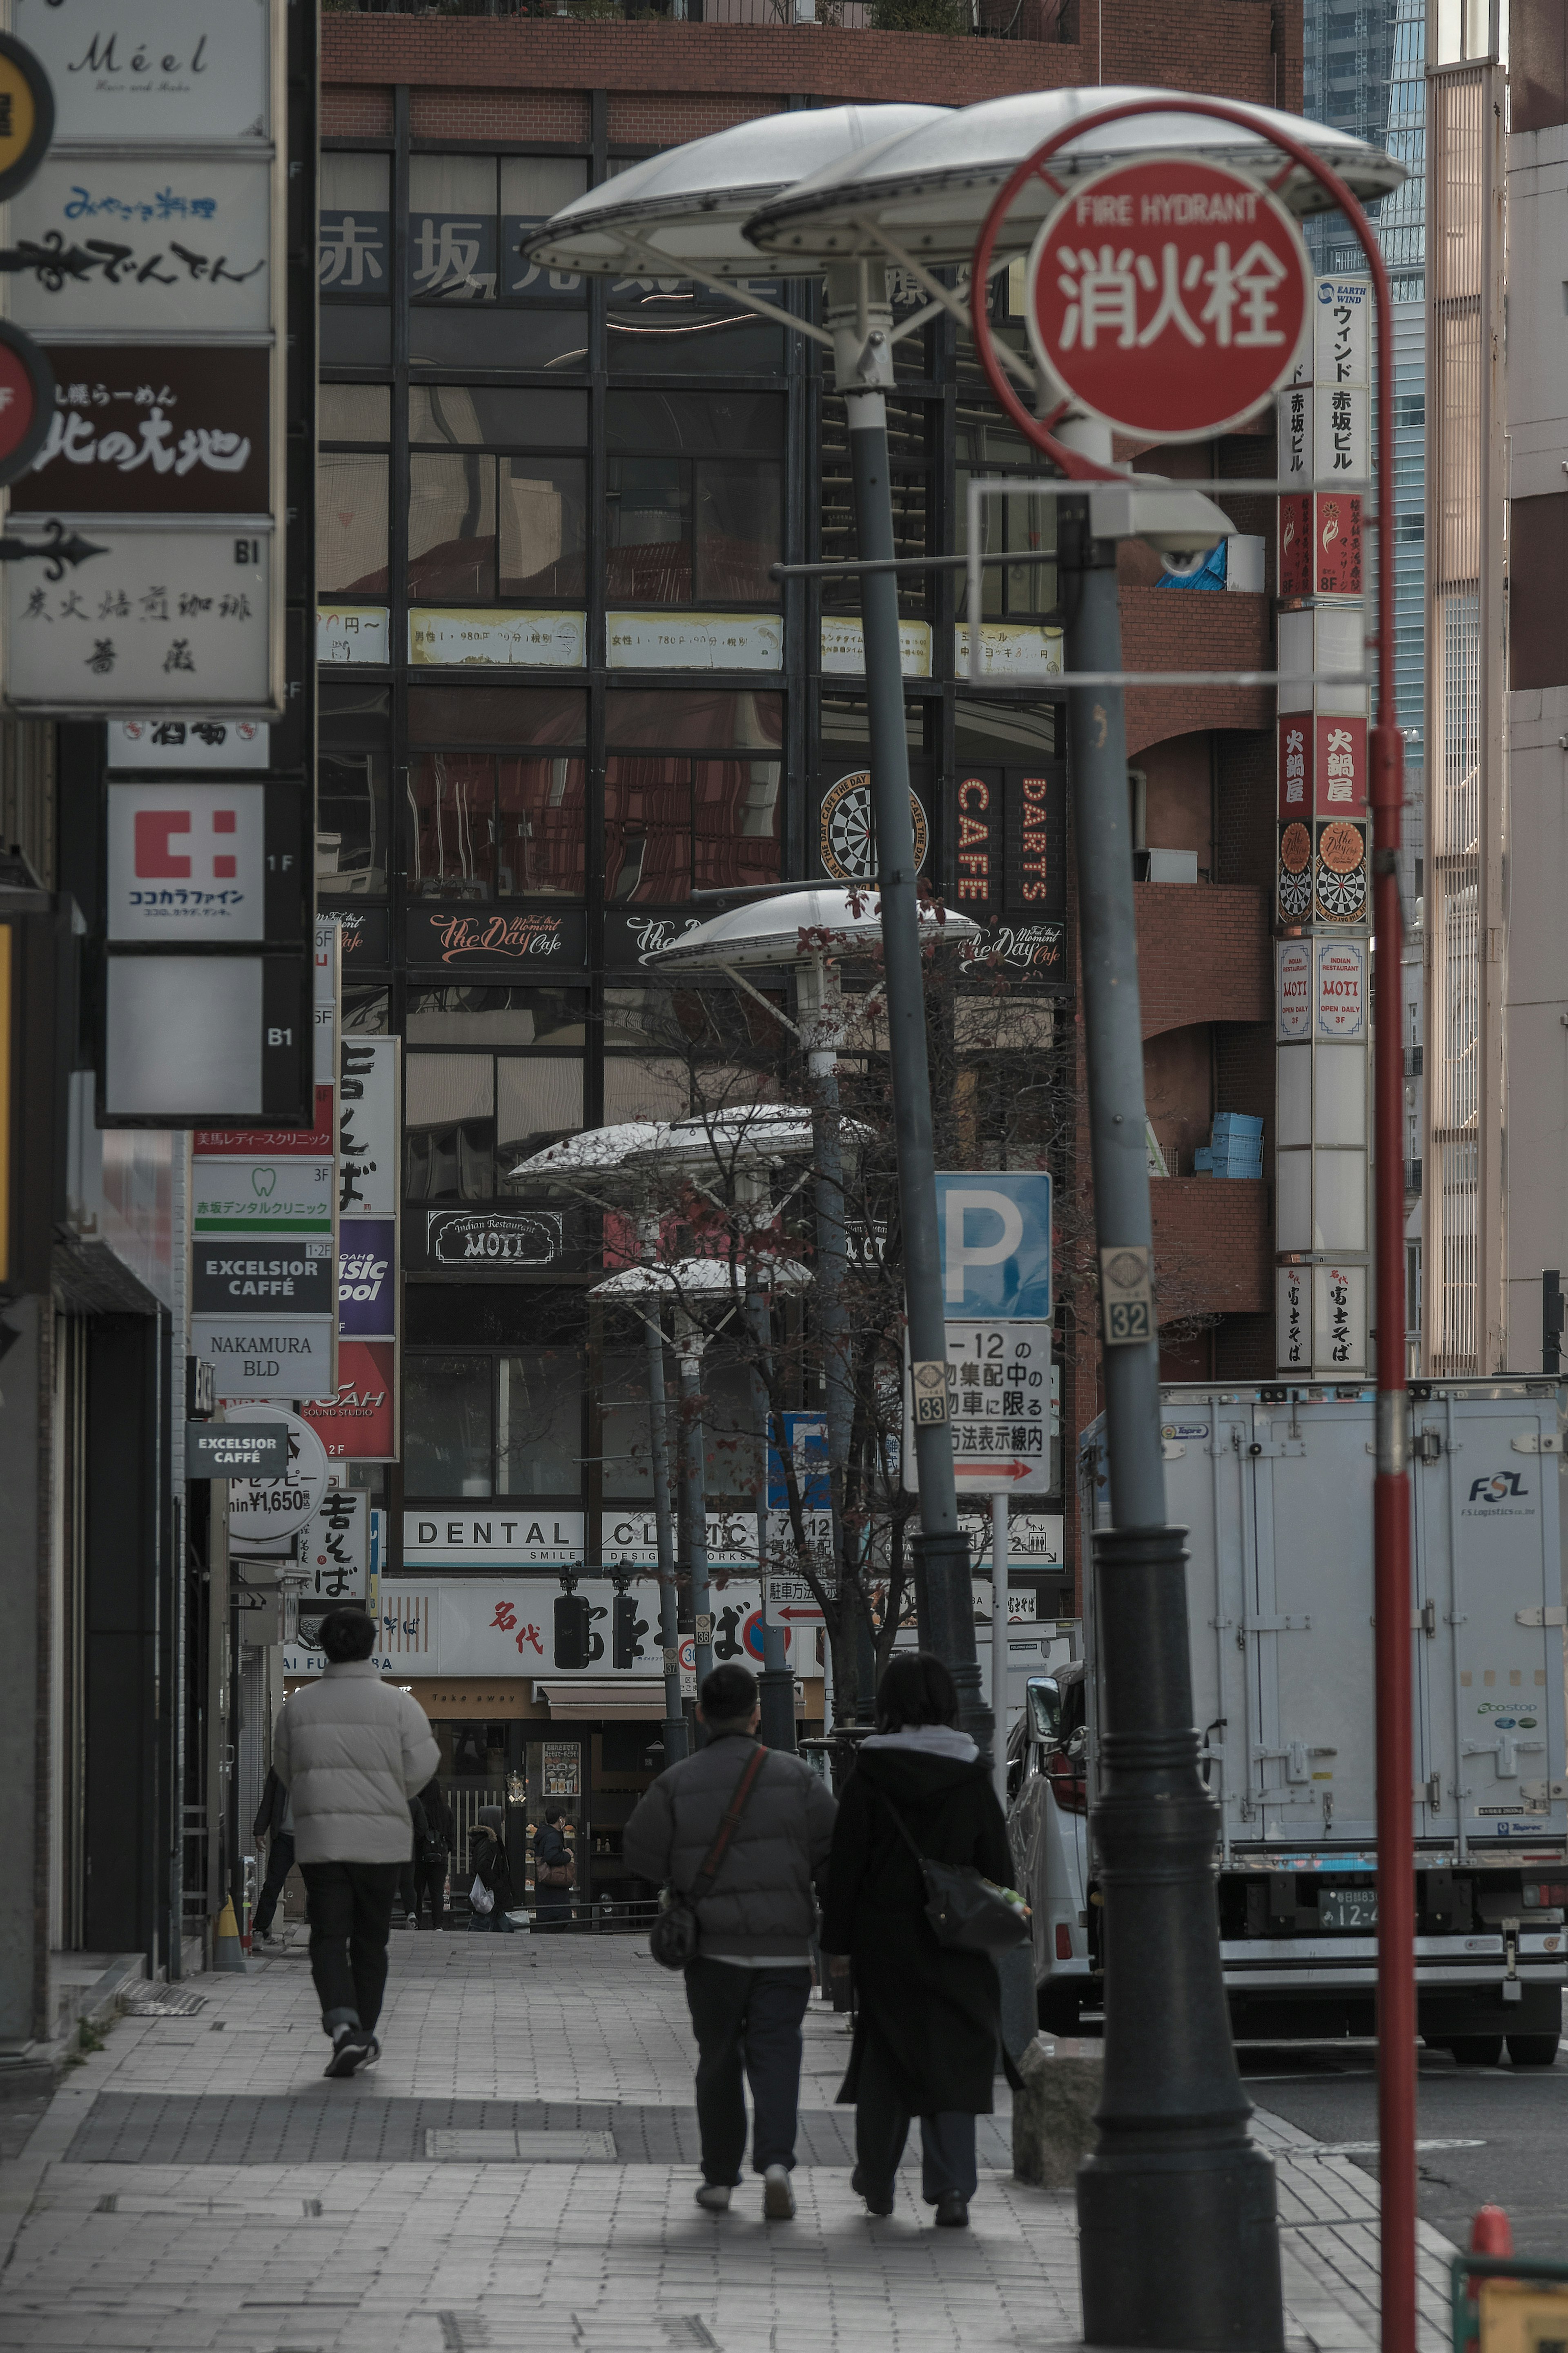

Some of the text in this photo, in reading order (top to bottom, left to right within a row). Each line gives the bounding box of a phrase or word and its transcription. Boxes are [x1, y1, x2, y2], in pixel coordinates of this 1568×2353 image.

[67, 31, 208, 73] Méel
[1075, 192, 1261, 226] FIRE HYDRANT
[1055, 240, 1288, 350] 消火栓
[1337, 286, 1367, 295] EARTH
[1337, 296, 1362, 304] WIND
[1332, 306, 1352, 470] ウィンド 赤坂ビル
[33, 407, 251, 475] 北の大地
[1290, 393, 1304, 472] 赤坂ビル
[1283, 579, 1293, 593] 8F
[1321, 577, 1337, 591] 8F
[19, 585, 252, 624] 炭火焙煎珈琲
[1286, 729, 1304, 803] 火鍋屋
[1327, 728, 1354, 803] 火鍋屋
[822, 798, 836, 820] CAFE
[834, 782, 850, 796] THE
[850, 776, 866, 785] DAY
[958, 778, 989, 899] CAFE
[1022, 778, 1047, 901] DARTS
[1333, 828, 1353, 844] The
[1325, 836, 1347, 854] Day
[267, 855, 294, 872] 1F
[129, 889, 244, 906] ココカラファイン
[543, 914, 564, 925] the
[430, 914, 559, 957] The Day Moment
[1045, 926, 1062, 937] the
[529, 934, 562, 956] Cafe
[992, 927, 1060, 967] Day Moment
[1033, 945, 1060, 966] Cafe
[1283, 980, 1307, 997] MOTI
[1323, 981, 1359, 996] MOTI
[267, 1028, 293, 1046] B1
[197, 1133, 330, 1145] 美馬レディースクリニック
[314, 1168, 329, 1181] 3F
[196, 1202, 327, 1215] 赤坂デンタルクリニック
[454, 1219, 536, 1234] Indian Restaurant
[464, 1232, 526, 1258] MOTI
[945, 1190, 1023, 1304] P
[205, 1260, 318, 1276] EXCELSIOR
[1288, 1270, 1301, 1285] 名代
[1329, 1269, 1349, 1285] 名代
[228, 1277, 295, 1296] CAFFÉ
[1113, 1303, 1147, 1336] 32
[1288, 1286, 1303, 1362] 富士そば
[1330, 1286, 1353, 1362] 富士そば
[211, 1336, 312, 1353] NAKAMURA
[245, 1361, 279, 1377] BLD
[921, 1398, 943, 1419] 33
[198, 1438, 276, 1450] EXCELSIOR
[329, 1444, 345, 1455] 2F
[214, 1450, 261, 1463] CAFFÉ
[1469, 1471, 1529, 1503] FSL
[249, 1490, 303, 1514] ¥1,650
[418, 1521, 570, 1545] DENTAL
[314, 1493, 358, 1597] 吉そば
[530, 1551, 577, 1560] SMILE
[770, 1582, 837, 1599] 駐車方法示
[1008, 1597, 1035, 1613] 富士そば
[490, 1600, 545, 1656] 名代
[698, 1631, 709, 1643] 36
[666, 1663, 677, 1674] 37
[432, 1693, 516, 1704] Take away
[1477, 1702, 1537, 1714] ecostop
